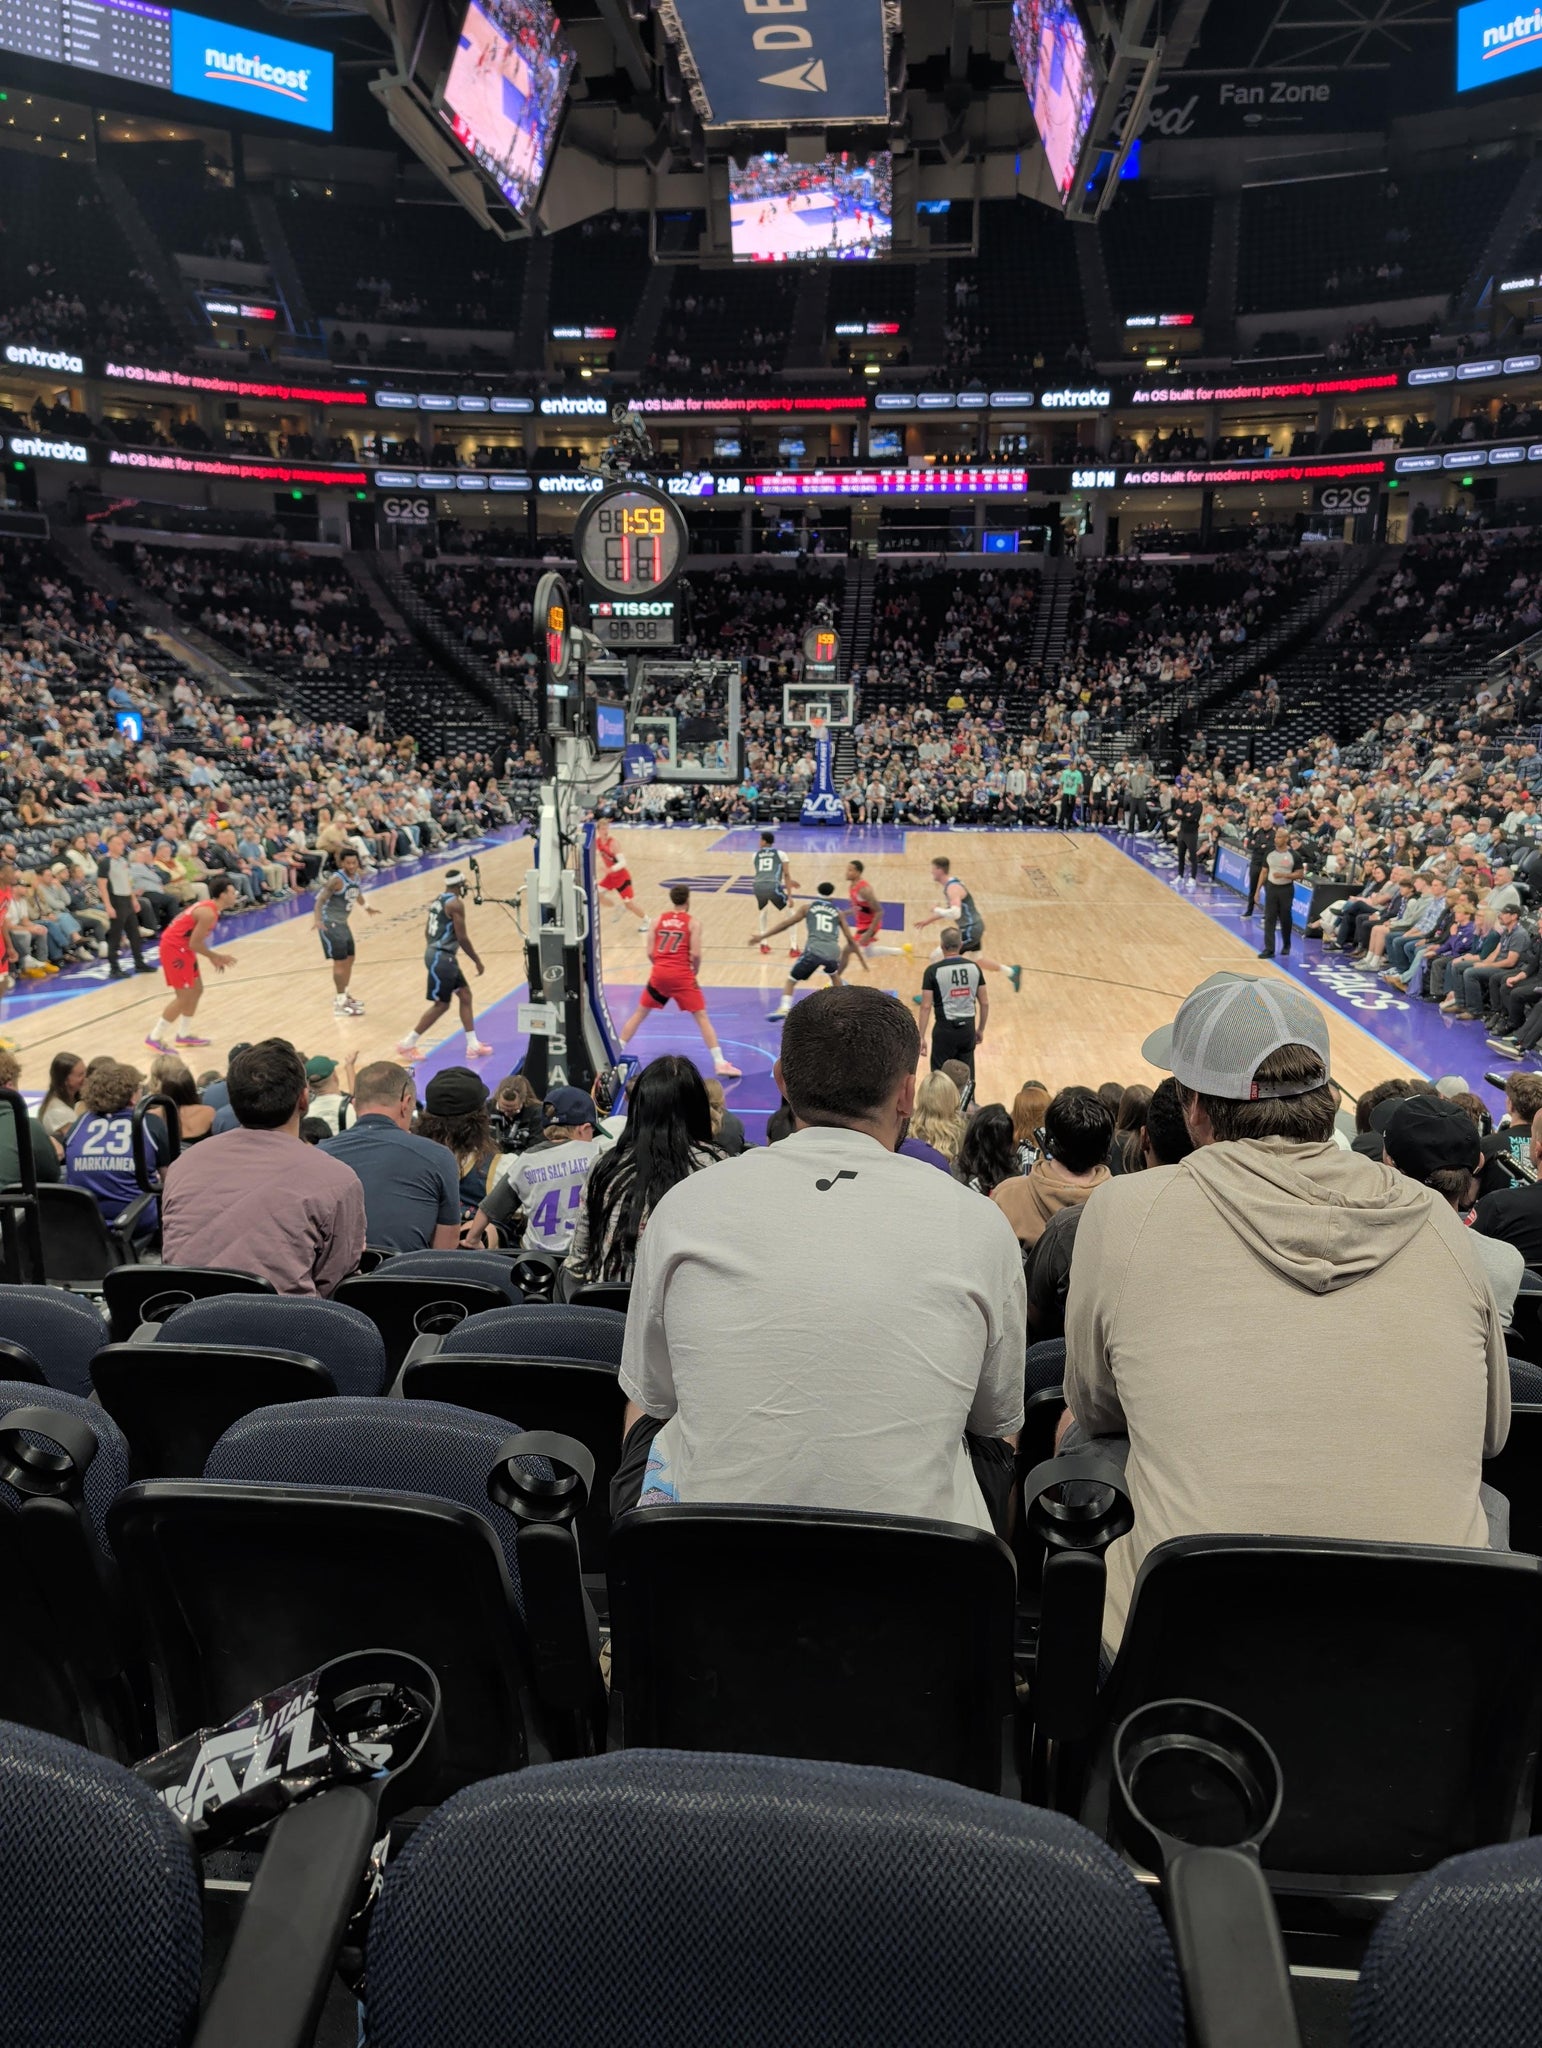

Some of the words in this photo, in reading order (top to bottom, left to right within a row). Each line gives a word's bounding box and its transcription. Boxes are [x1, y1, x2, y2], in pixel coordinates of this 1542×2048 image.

[1483, 8, 1542, 47] nutri
[205, 48, 308, 91] nutricost
[1220, 83, 1264, 105] Fan
[1270, 81, 1330, 103] Zone
[6, 346, 83, 373] entrata
[106, 362, 124, 377] An
[125, 365, 144, 380] OS
[145, 367, 172, 384] built
[173, 371, 192, 386] for
[192, 377, 238, 392] modern
[238, 382, 290, 399] property
[1133, 390, 1149, 402] An
[1151, 389, 1168, 402] OS
[1169, 388, 1195, 401] built
[1196, 386, 1214, 400] for
[1215, 384, 1260, 399] modern
[1262, 380, 1314, 399] property
[1316, 374, 1397, 393] management
[541, 395, 607, 414] entrata
[628, 399, 643, 411] An
[645, 399, 661, 411] OS
[662, 398, 686, 411] built
[687, 398, 703, 410] for
[704, 398, 746, 410] modern
[747, 398, 792, 412] property
[795, 397, 866, 411] management
[1041, 388, 1110, 407] entrata
[11, 437, 87, 462] entrata
[110, 450, 128, 465] An
[129, 453, 147, 467] OS
[148, 454, 173, 469] built
[175, 456, 194, 471] for
[194, 461, 240, 475] modern
[240, 465, 291, 482] property
[1124, 472, 1141, 484] An
[1142, 471, 1159, 484] OS
[1160, 470, 1185, 483] built
[1187, 470, 1204, 482] for
[1205, 468, 1250, 481] modern
[1251, 467, 1303, 481] property
[1305, 461, 1385, 478] management
[1097, 470, 1115, 487] PM
[383, 497, 430, 518] G2G
[1321, 486, 1371, 508] G2G
[623, 508, 665, 534] 1:59
[621, 535, 661, 583] 11
[612, 603, 674, 616] TISSOT
[759, 857, 774, 872] 19
[815, 913, 833, 933] 16
[658, 930, 686, 953] 77
[951, 968, 969, 986] 48
[1308, 971, 1410, 1010] PACS
[82, 1118, 132, 1155] 23
[524, 1167, 547, 1185] SOUTH
[547, 1161, 567, 1180] SALT
[569, 1157, 590, 1174] LAKE
